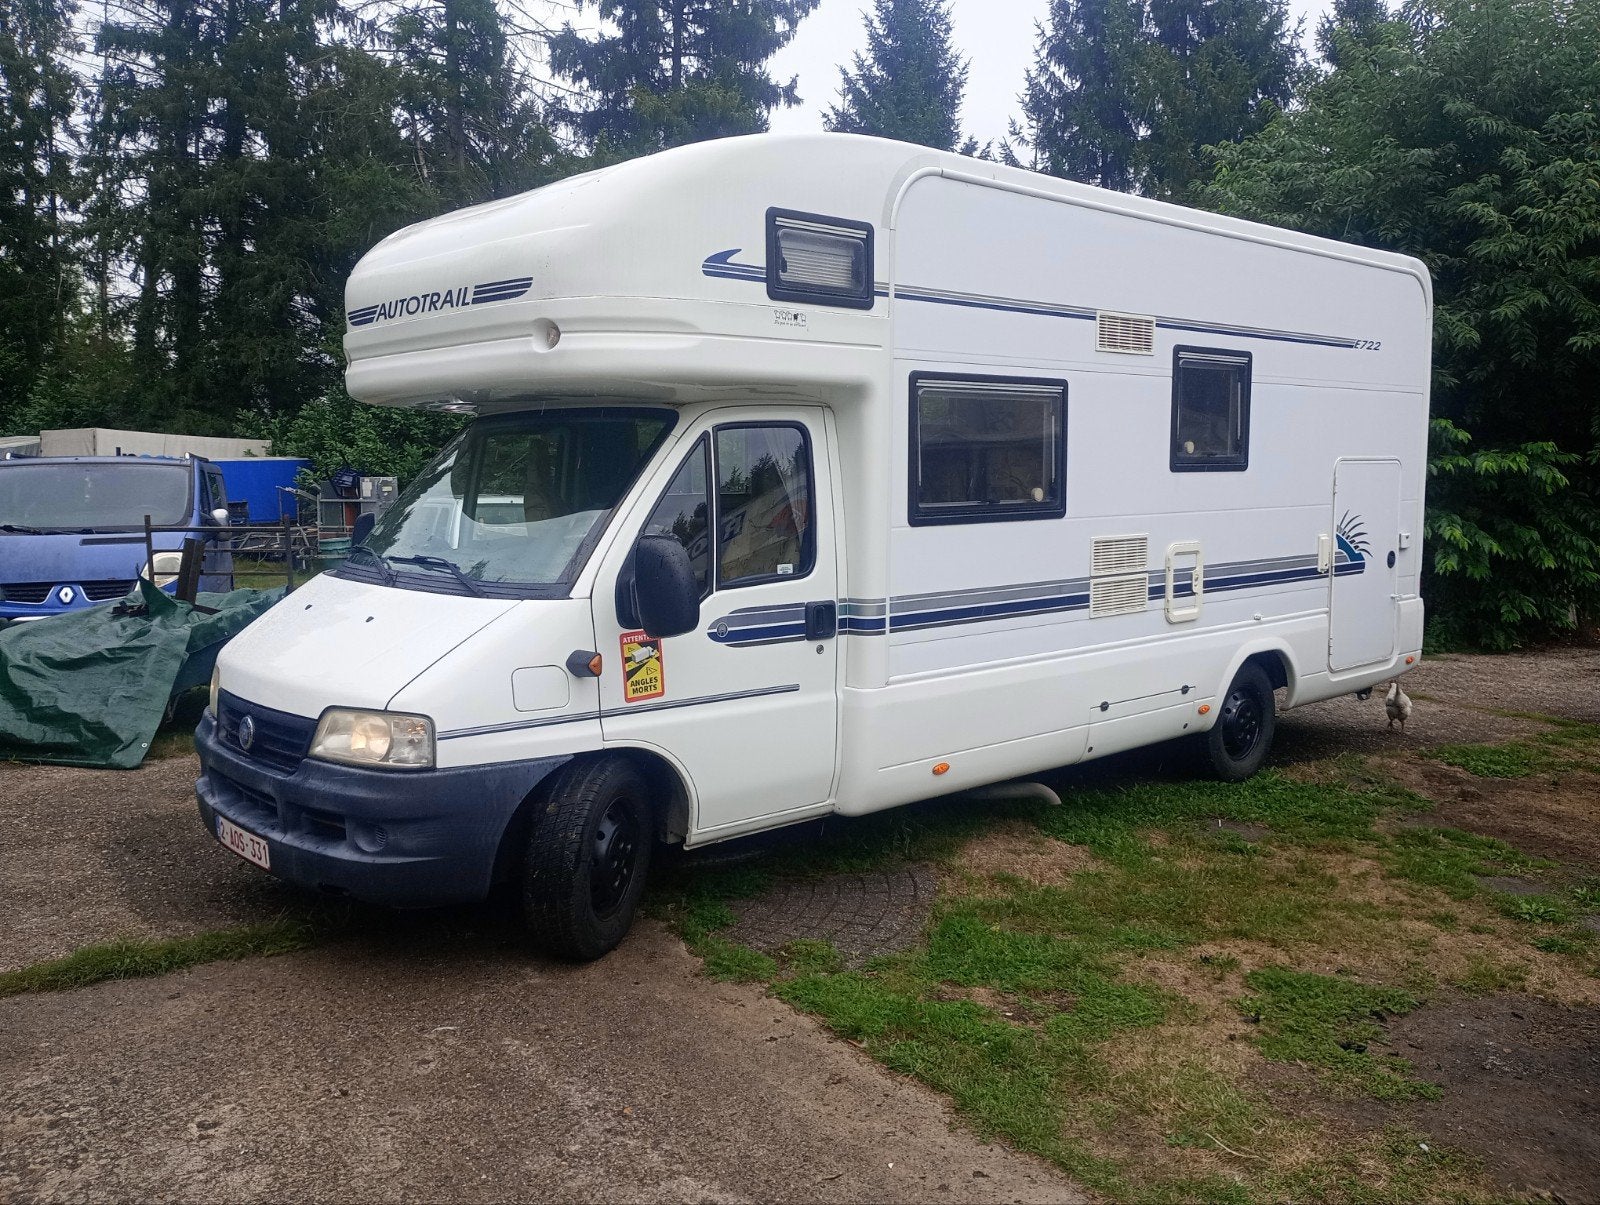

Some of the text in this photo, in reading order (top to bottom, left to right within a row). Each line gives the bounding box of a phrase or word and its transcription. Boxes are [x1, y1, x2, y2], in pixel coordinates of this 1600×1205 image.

[375, 286, 471, 322] AUTOTRAIL
[1354, 339, 1381, 351] E722
[623, 634, 657, 644] ATTENT
[630, 676, 659, 688] ANGLES
[632, 684, 658, 695] MORTS
